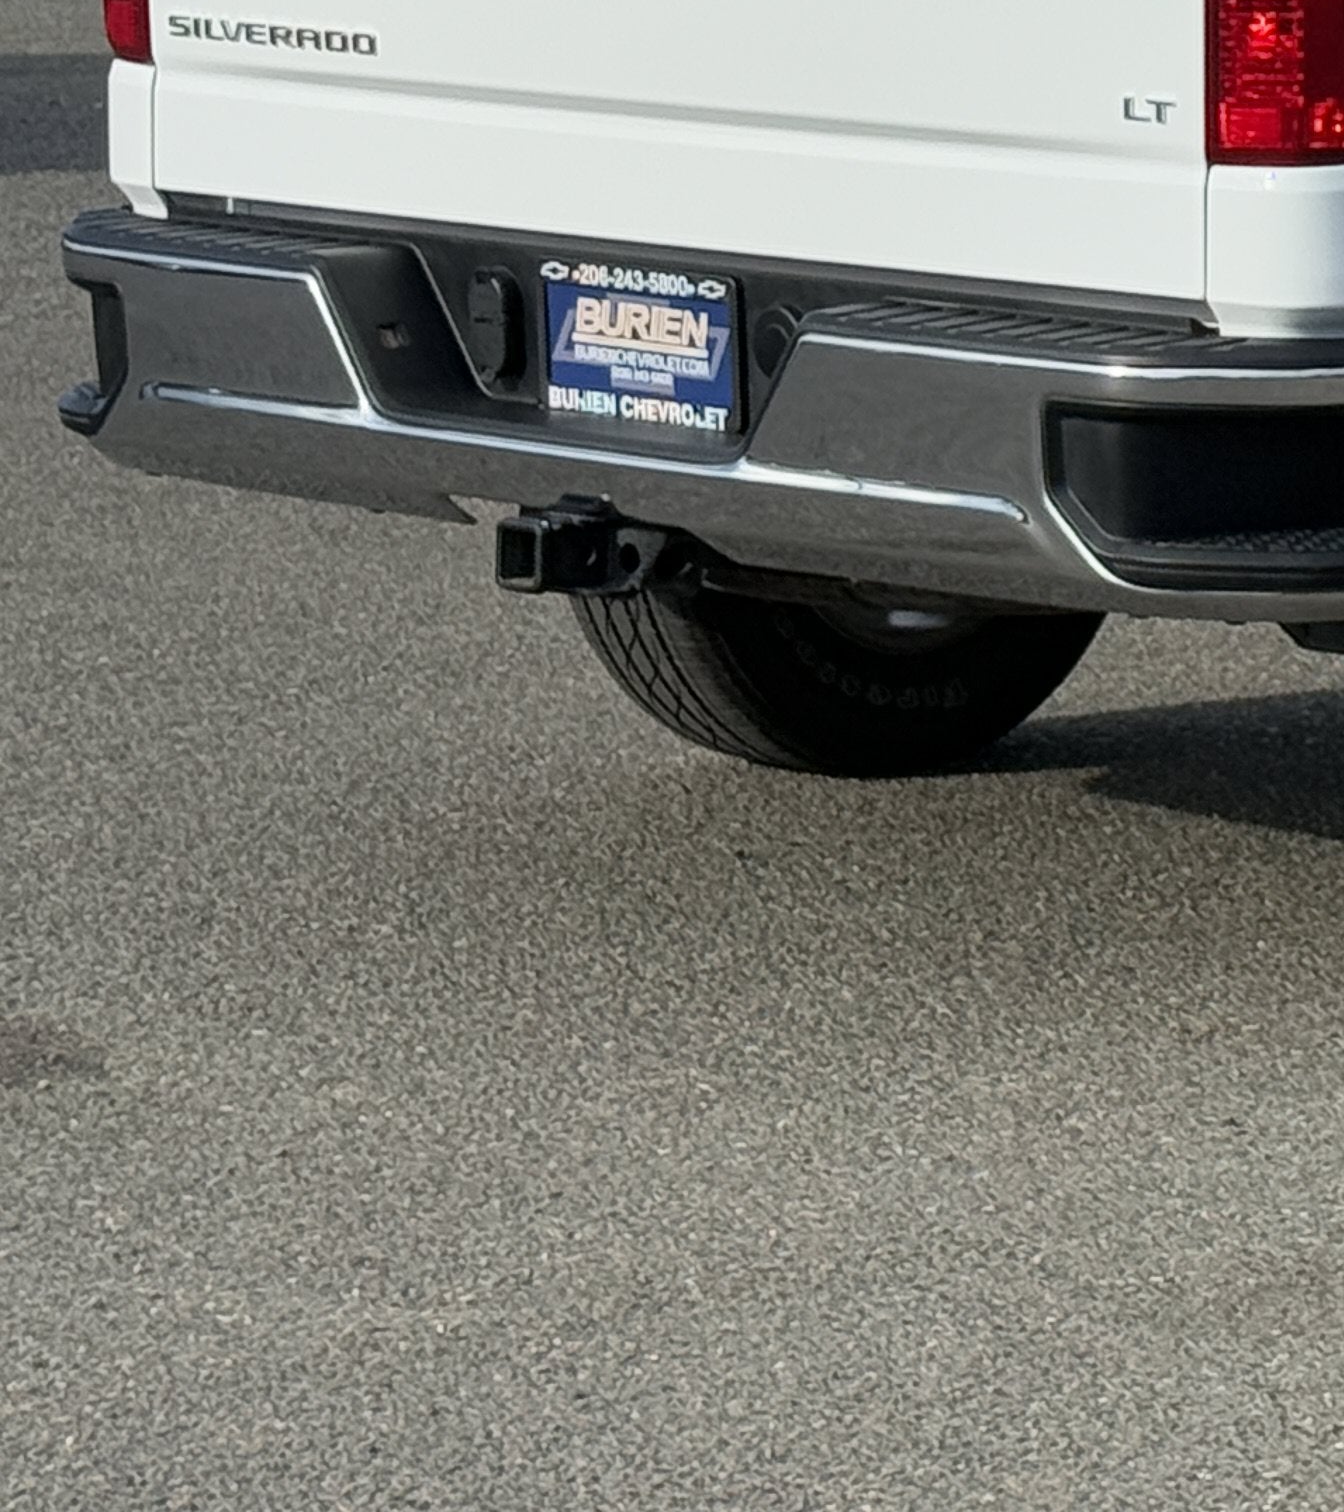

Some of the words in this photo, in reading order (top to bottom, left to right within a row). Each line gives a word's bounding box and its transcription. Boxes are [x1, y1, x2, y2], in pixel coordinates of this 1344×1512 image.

[167, 14, 380, 57] SILVERADO
[1121, 94, 1177, 125] LT
[574, 296, 710, 348] BURIEN
[547, 385, 617, 416] BURIEN
[619, 397, 729, 432] CHEVROLET
